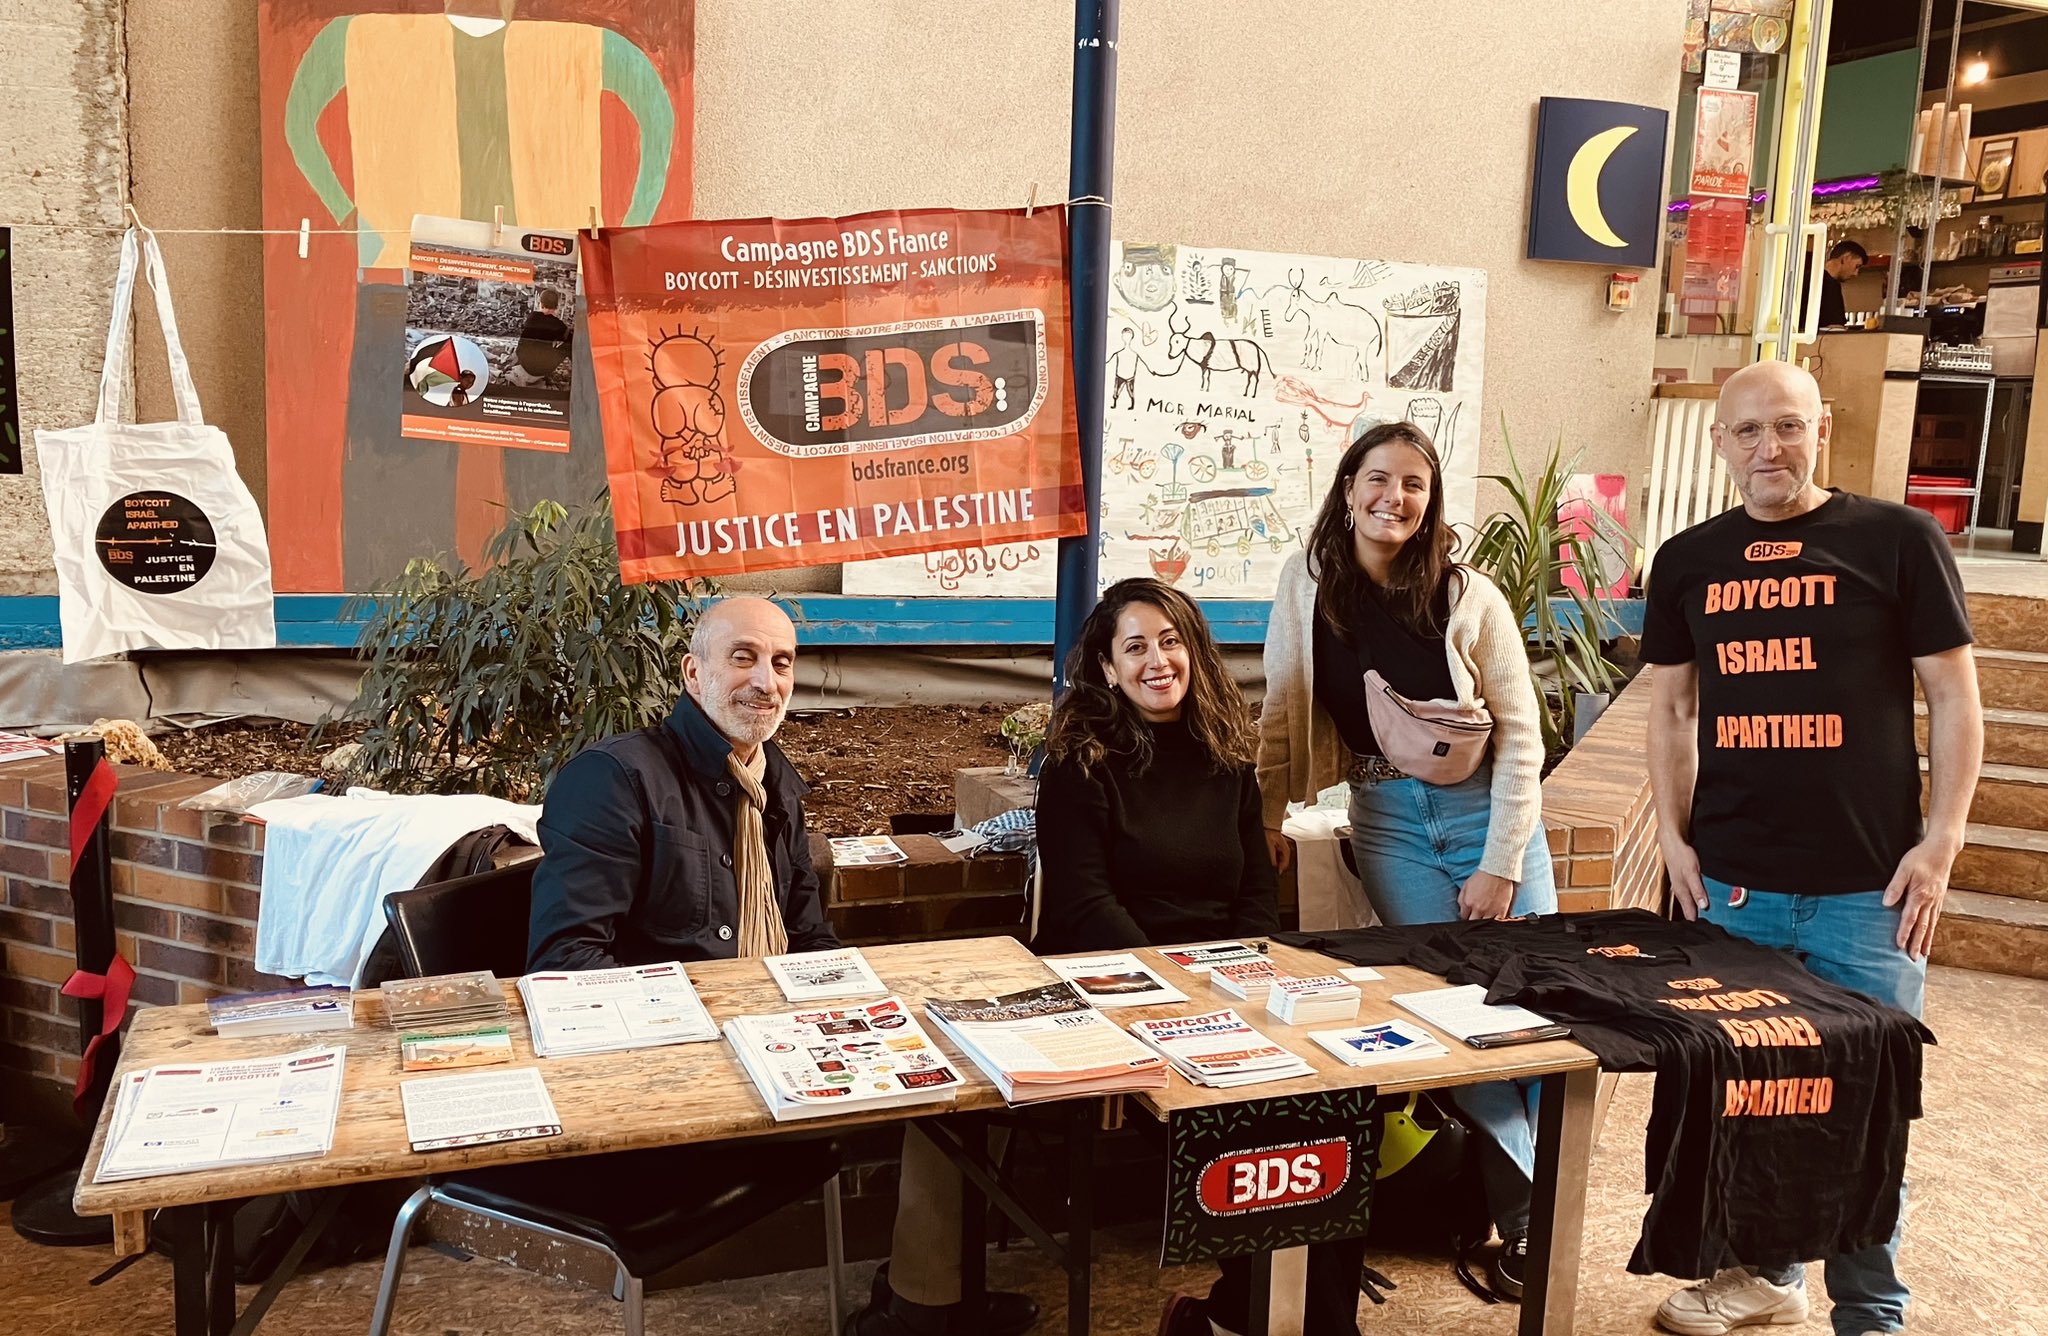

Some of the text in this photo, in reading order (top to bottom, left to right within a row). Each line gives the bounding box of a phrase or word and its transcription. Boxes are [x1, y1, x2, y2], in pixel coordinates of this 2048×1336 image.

[531, 236, 565, 254] BDS
[720, 227, 948, 266] Campagne BDS France
[664, 271, 740, 291] BOYCOTT
[753, 262, 908, 289] DÉSINVESTISSEMENT
[920, 253, 998, 278] SANCTIONS
[802, 354, 820, 432] CAMPAGNE
[818, 341, 994, 432] BDS
[1196, 403, 1256, 422] MARIAL
[852, 453, 970, 482] bdsfrance.org
[124, 499, 171, 508] BOYCOTT
[675, 487, 1035, 558] JUSTICE EN PALESTINE
[108, 550, 134, 560] BDS
[145, 555, 194, 564] JUSTICE
[1750, 544, 1787, 558] BDS
[178, 564, 196, 572] EN
[134, 574, 196, 584] PALESTINE
[1704, 574, 1837, 614] BOYCOTT
[1716, 637, 1817, 675] ISRAEL
[1716, 714, 1842, 748] APARTHEID
[780, 956, 852, 967] PALESTINE
[1278, 976, 1335, 987] BOYCOTT
[1054, 1015, 1095, 1026] BDS
[1144, 1012, 1232, 1030] BOYCOTT
[1152, 1021, 1243, 1038] Carrefour
[1718, 1016, 1822, 1048] ISRAEL
[1190, 1052, 1247, 1062] BOYCOTT
[218, 1072, 280, 1082] BOYCOTTER
[908, 1072, 942, 1082] BDS
[1722, 1077, 1834, 1118] APARTHEID
[1233, 1154, 1321, 1204] BDS
